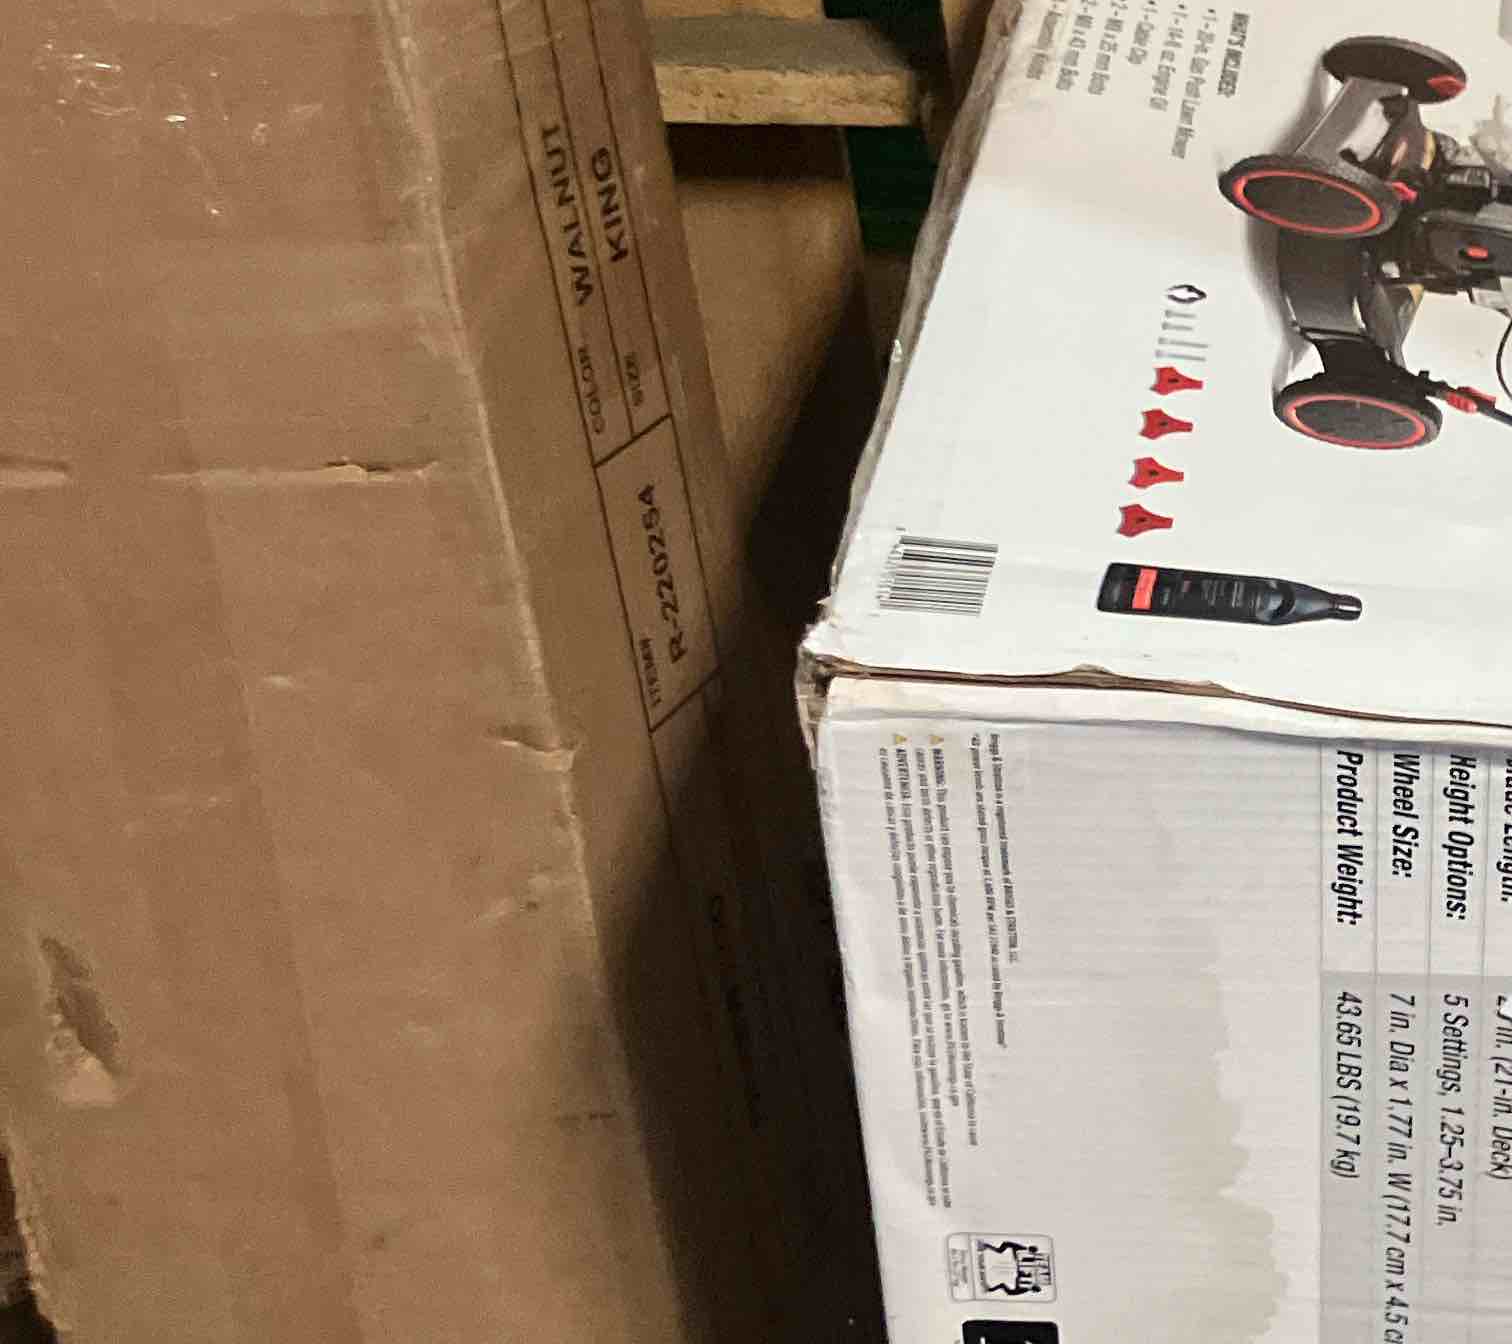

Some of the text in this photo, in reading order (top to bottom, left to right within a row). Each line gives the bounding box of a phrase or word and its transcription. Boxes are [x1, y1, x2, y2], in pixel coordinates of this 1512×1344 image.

[541, 125, 594, 307] WALNUT
[591, 145, 629, 264] KING
[1391, 753, 1420, 879] Wheel Size:
[1331, 750, 1364, 926] Product Weight:
[1441, 754, 1476, 921] Height Options:
[1389, 993, 1415, 1007] 7
[1443, 993, 1469, 1008] 5
[1388, 1010, 1416, 1033] in.
[1389, 1041, 1415, 1072] Dia
[1435, 1012, 1470, 1096] Settings,
[1329, 992, 1362, 1179] 43.65 LBS (19.7 kg)
[1387, 1097, 1414, 1139] 1.77
[1387, 1142, 1413, 1164] in.
[1387, 1172, 1413, 1193] W
[1380, 1195, 1411, 1244] (17.7
[1384, 1247, 1406, 1276] cm
[1384, 1296, 1409, 1326] 4.5
